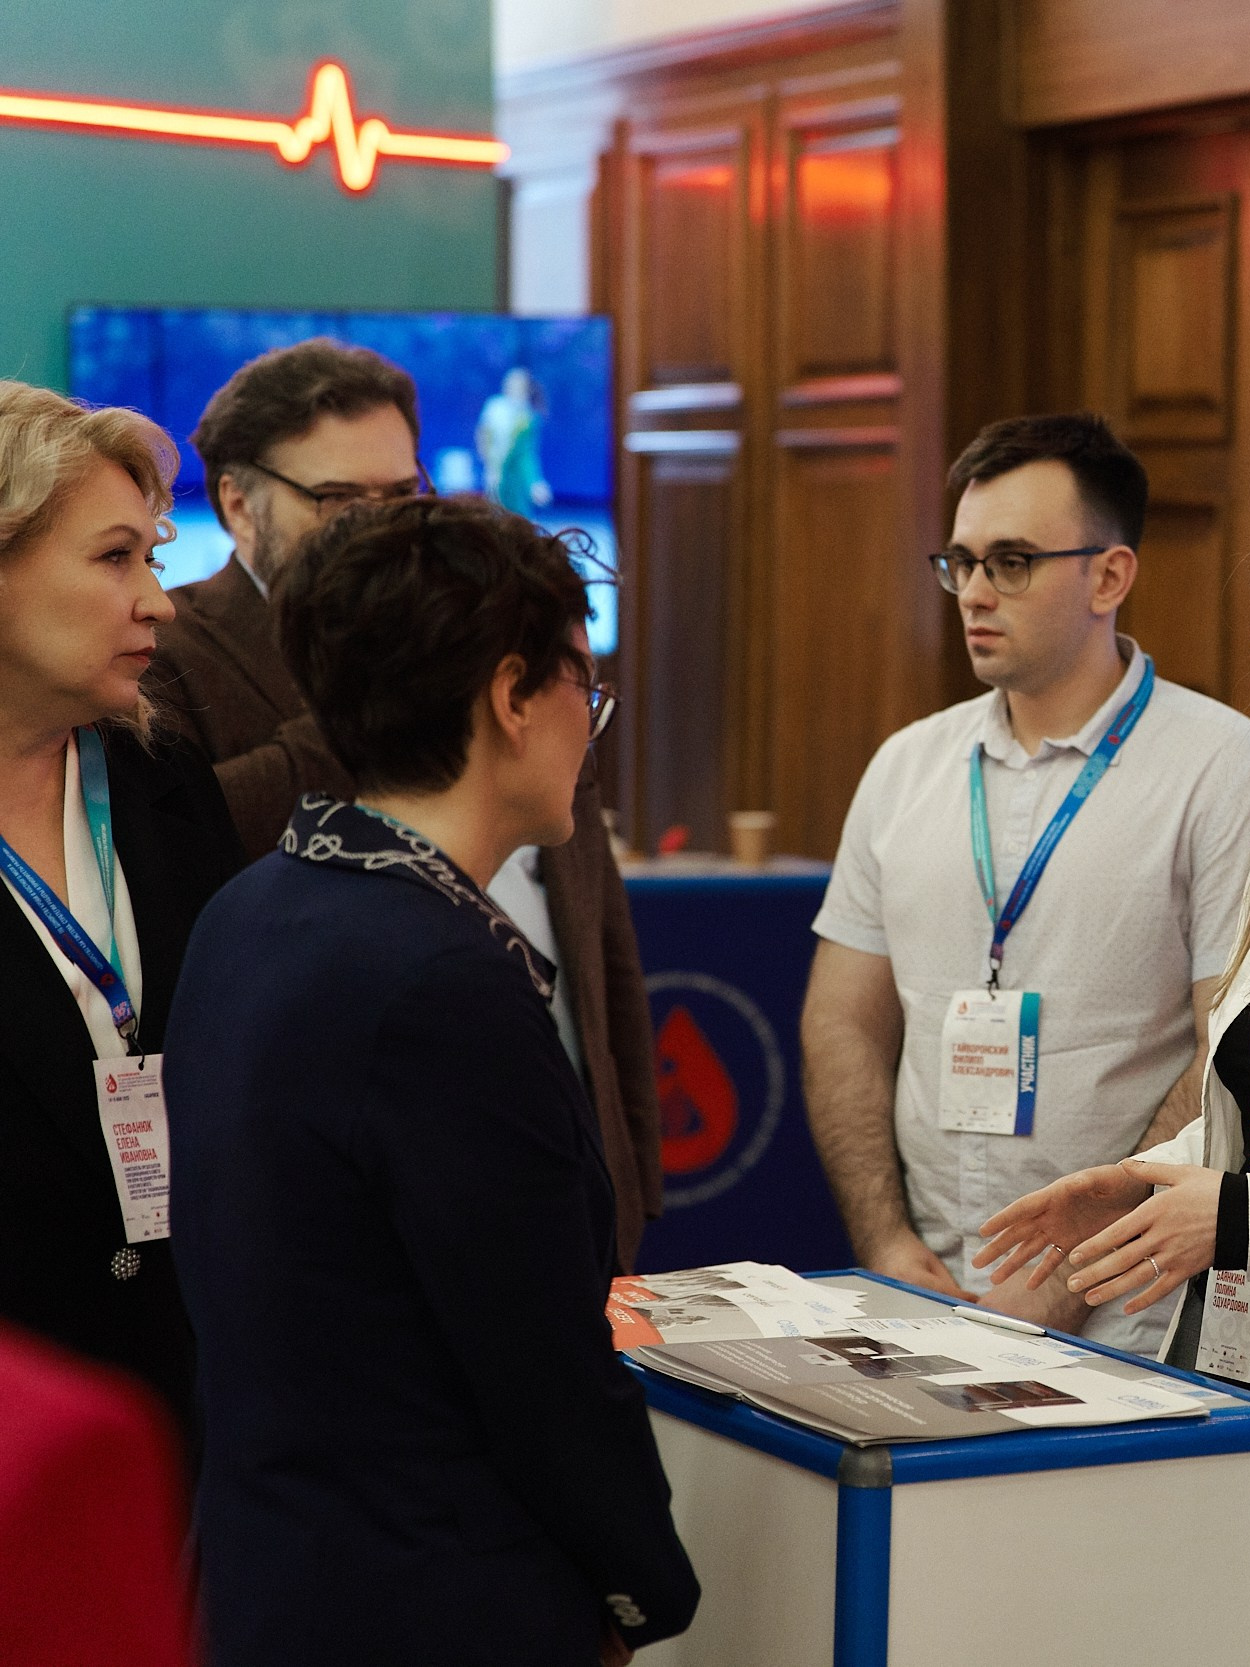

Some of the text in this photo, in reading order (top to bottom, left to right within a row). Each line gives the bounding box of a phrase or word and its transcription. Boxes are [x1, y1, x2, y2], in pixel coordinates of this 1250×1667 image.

[1020, 1035, 1036, 1093] УЧАСТНИК
[112, 1120, 153, 1136] СТЕФАНЮК
[116, 1137, 140, 1150] ЕЛЕНА
[119, 1149, 158, 1164] ИВАНОВНА
[1214, 1282, 1236, 1297] ПОЛИНА
[1212, 1296, 1248, 1313] ЭДУАРДОВНА
